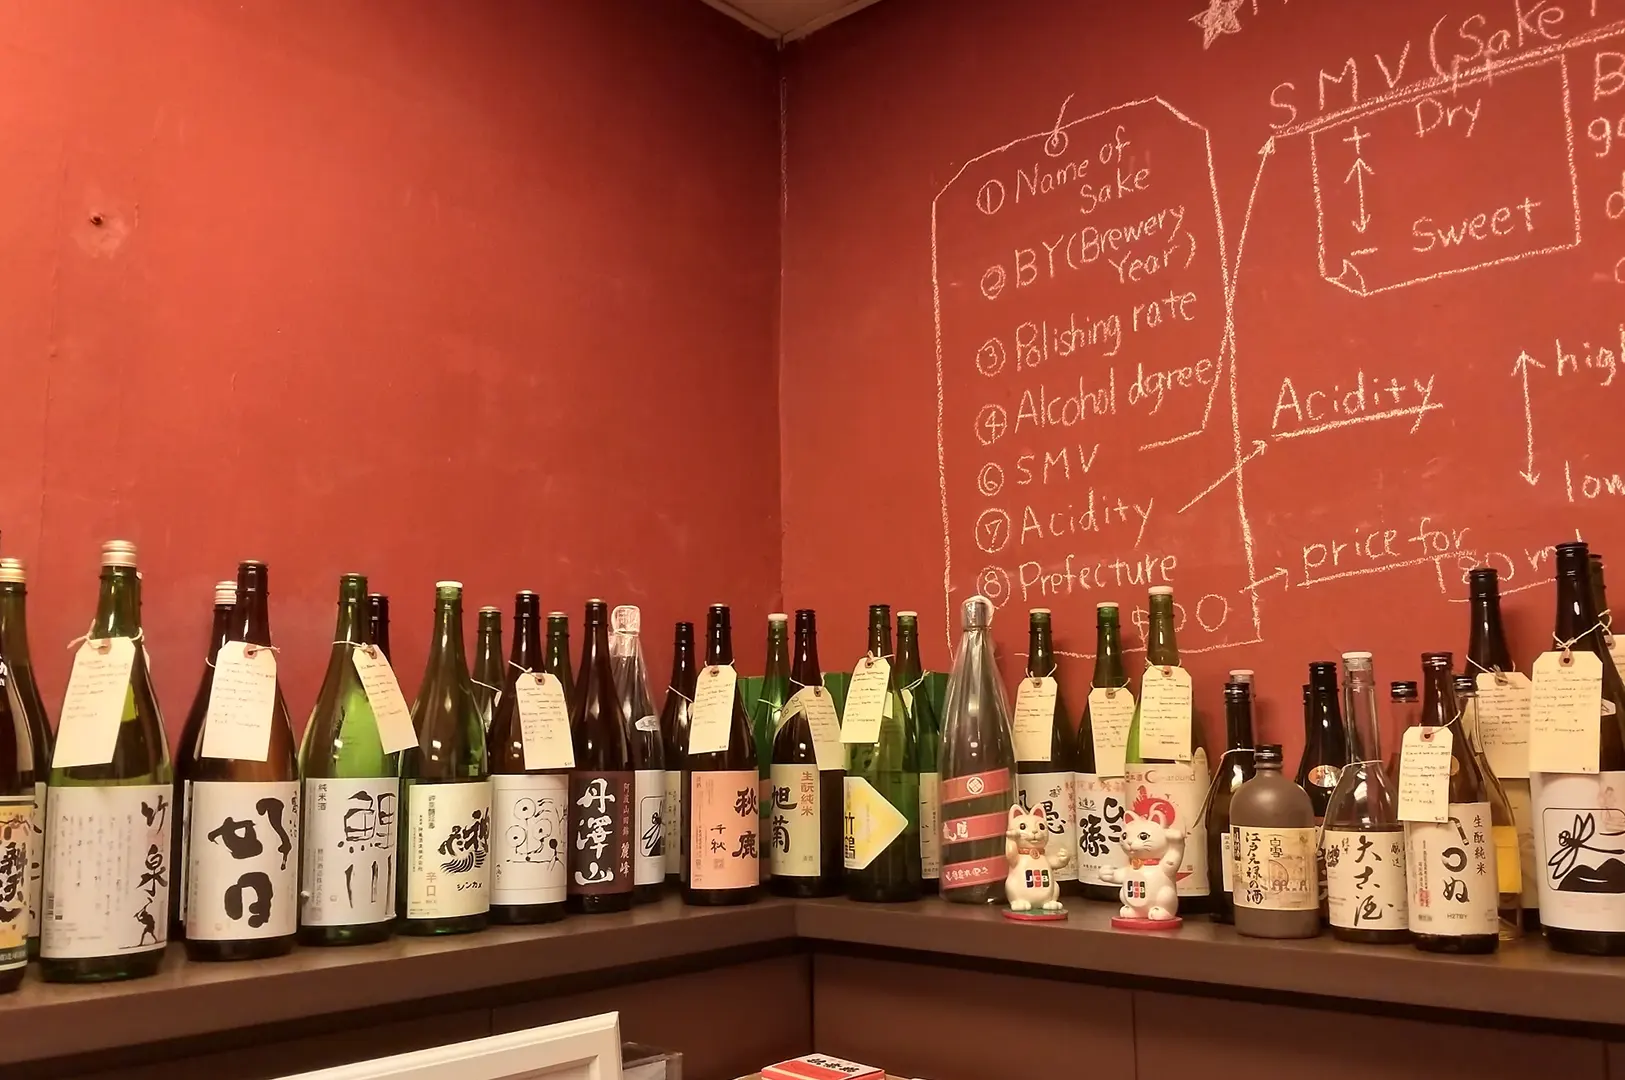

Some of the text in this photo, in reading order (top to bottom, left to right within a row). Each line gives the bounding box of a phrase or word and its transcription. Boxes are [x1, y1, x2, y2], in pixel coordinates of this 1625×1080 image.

[1415, 97, 1482, 139] Dry
[1015, 155, 1089, 204] Name
[1099, 124, 1131, 167] of
[1079, 167, 1151, 214] Sake
[1411, 196, 1542, 254] Sweet
[1015, 313, 1121, 371] Polishing
[1132, 292, 1197, 330] rate
[1015, 366, 1117, 436] Alcohol
[1128, 355, 1216, 416] dgree
[1271, 367, 1436, 436] Acidity
[1015, 444, 1101, 486] SMV
[1020, 487, 1154, 550] Acidity
[1302, 517, 1470, 590] price for
[133, 793, 170, 898] 竹泉
[574, 777, 617, 887] 丹澤山
[731, 786, 759, 859] 秋鹿
[1473, 814, 1487, 876] 生酛純米
[426, 872, 436, 897] 辛口
